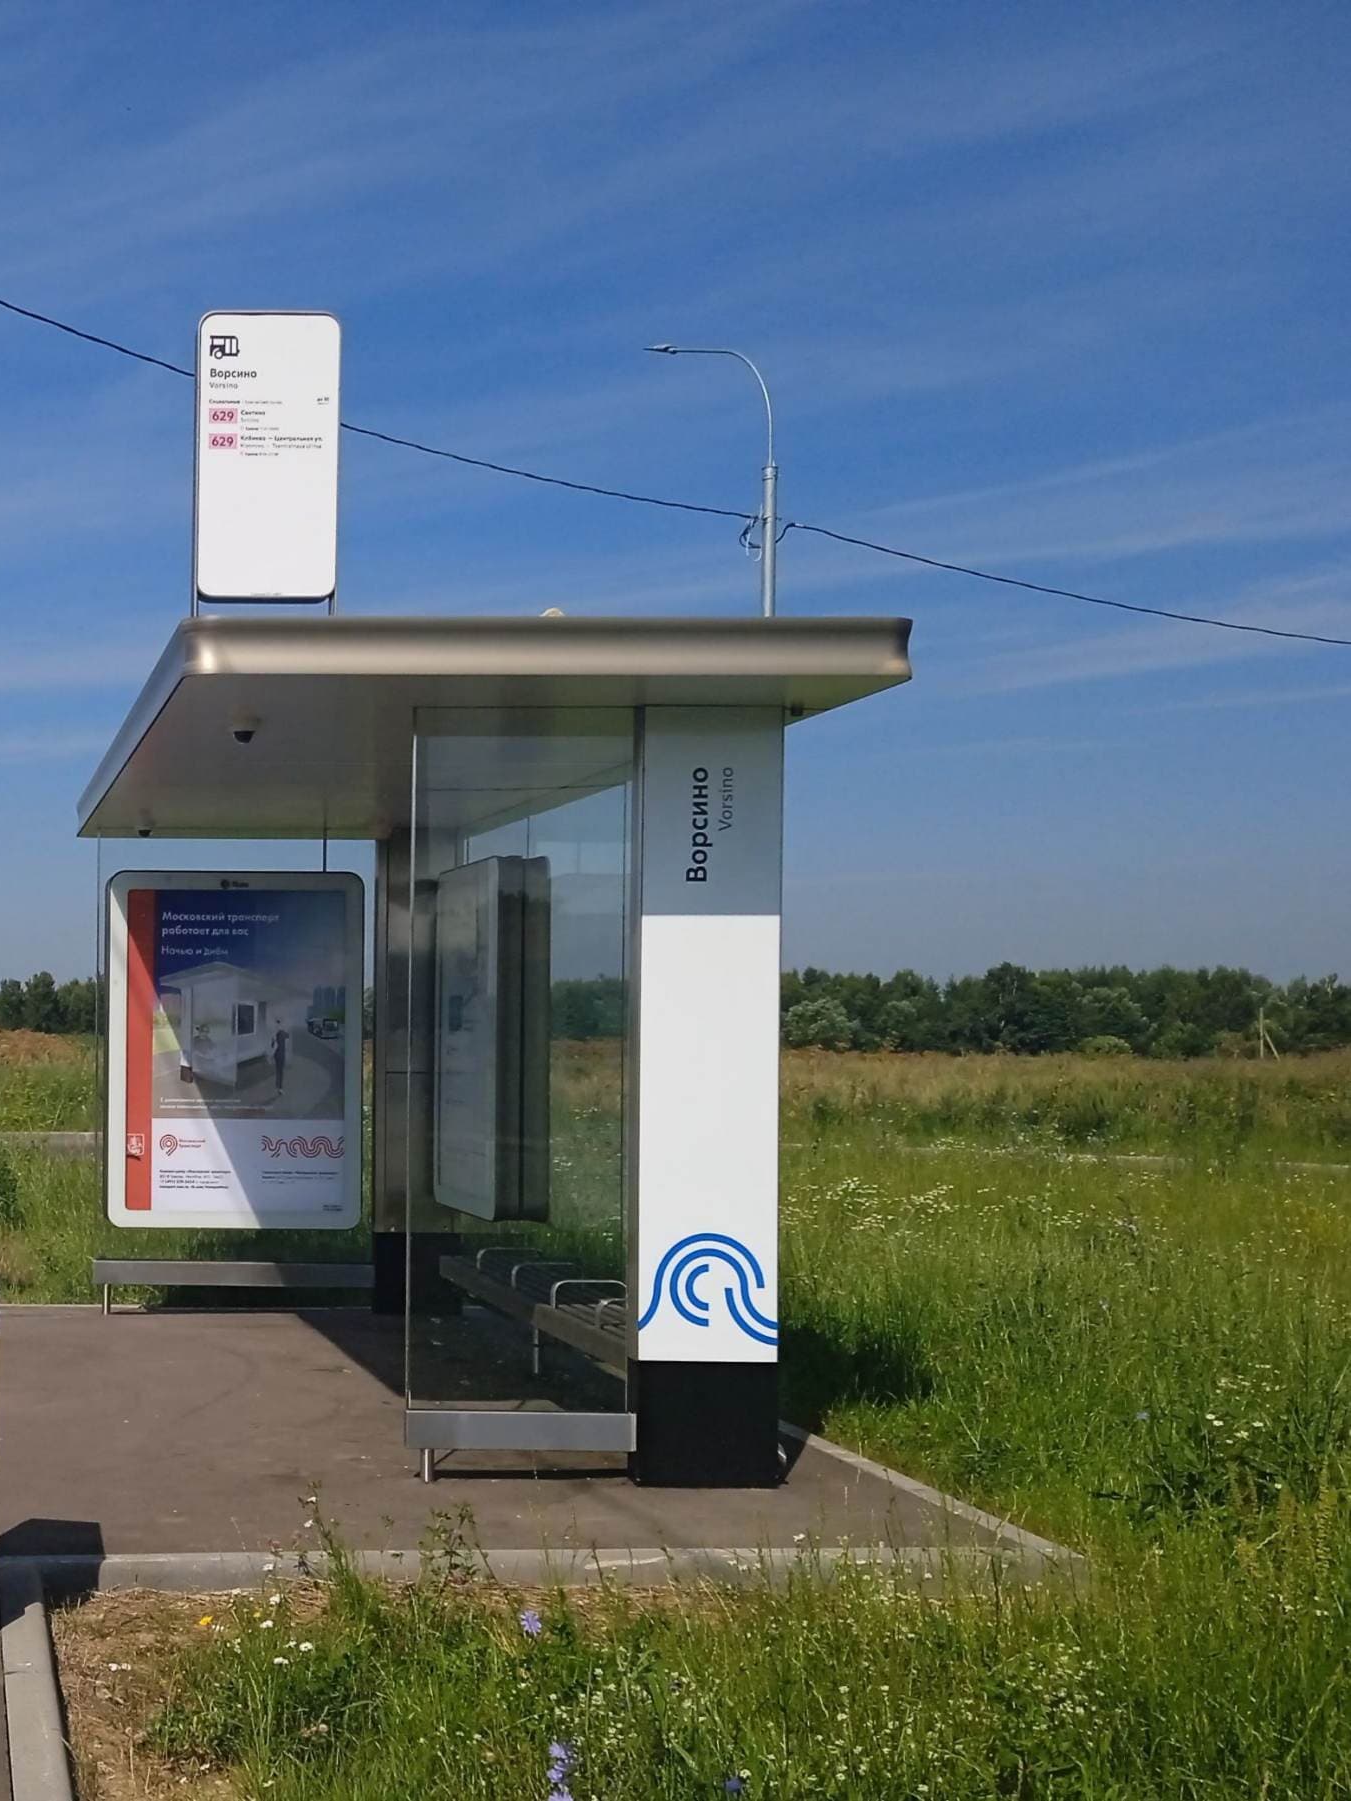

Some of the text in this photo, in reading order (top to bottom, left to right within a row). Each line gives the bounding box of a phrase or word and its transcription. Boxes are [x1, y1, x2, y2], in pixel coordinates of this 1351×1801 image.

[209, 368, 258, 379] Ворсино
[212, 411, 235, 421] 629
[211, 436, 234, 447] 629
[718, 767, 734, 831] Vorsino
[685, 767, 713, 882] Ворсино
[162, 912, 280, 923] Московский транспорт
[162, 925, 249, 937] работает для вас
[161, 945, 194, 955] Ночью
